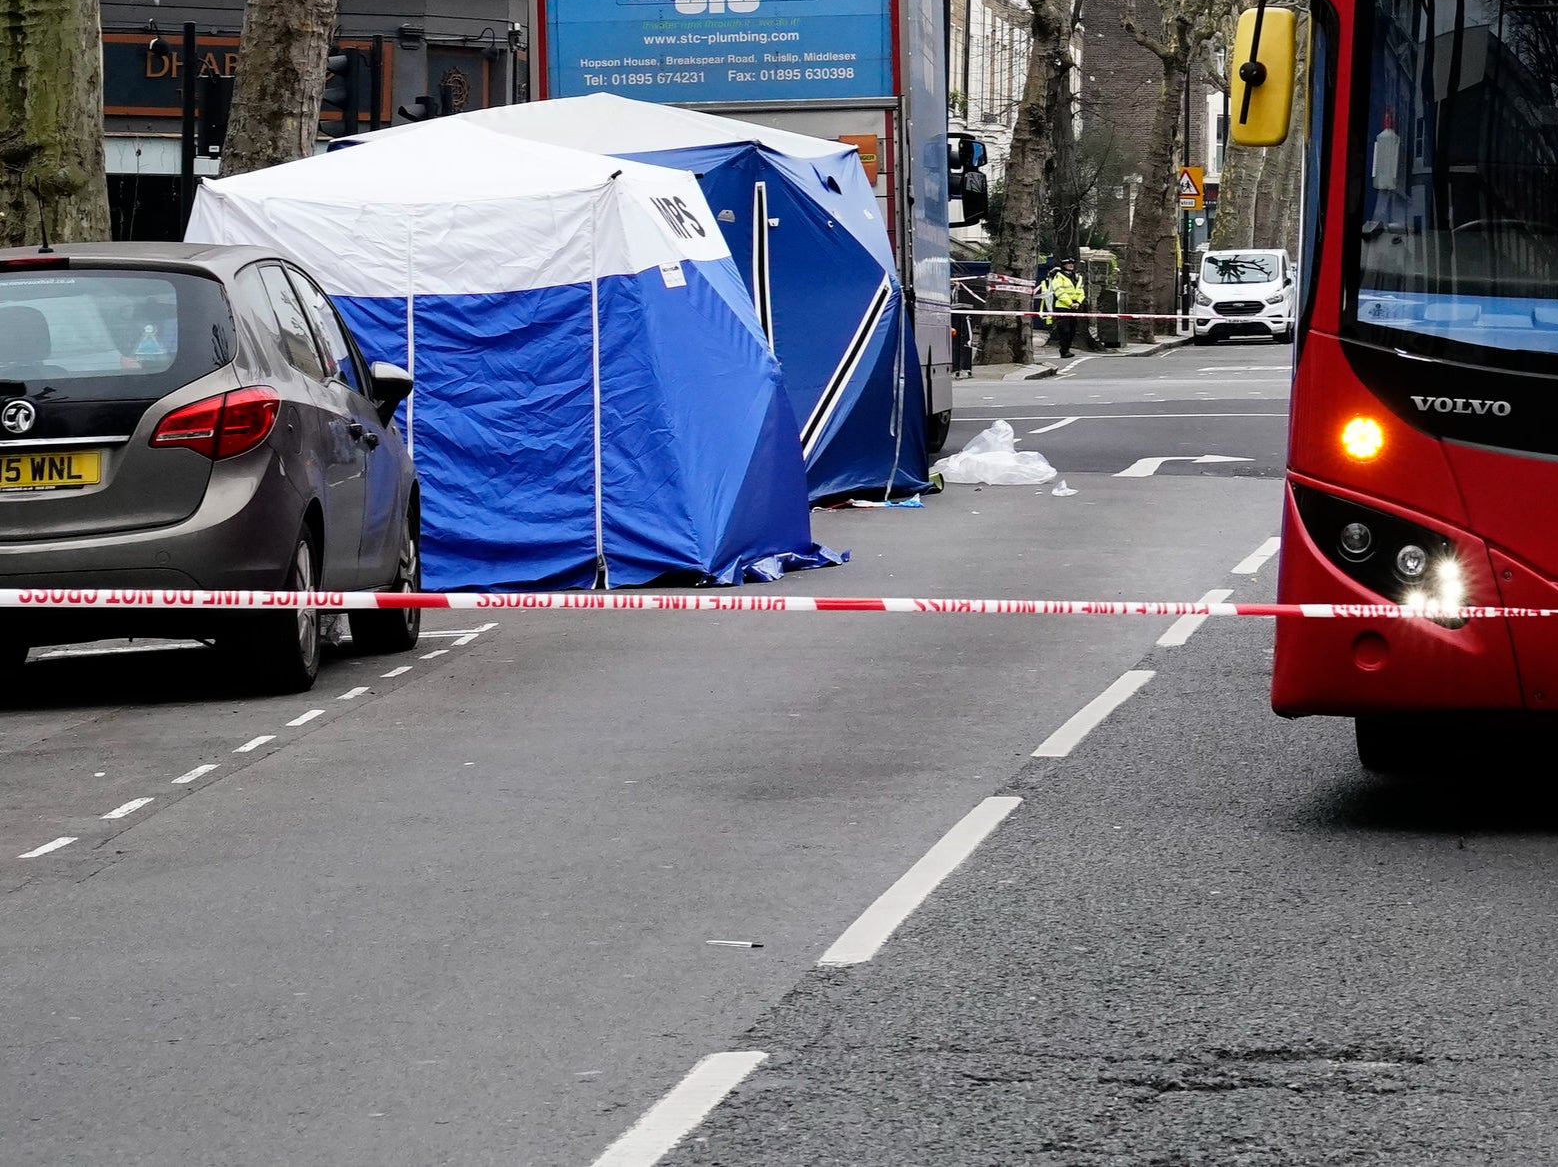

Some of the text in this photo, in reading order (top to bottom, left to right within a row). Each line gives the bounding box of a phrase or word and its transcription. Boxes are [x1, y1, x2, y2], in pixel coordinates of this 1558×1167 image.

[643, 31, 800, 45] www.stc-plumbing.com
[580, 57, 621, 69] Hopson
[666, 54, 724, 66] Breakspear
[804, 50, 856, 62] Middlesex
[584, 68, 855, 86] Tel: 01895 674231 Fax: 01895 630398
[648, 195, 706, 239] MPS
[1410, 395, 1511, 416] VOLVO
[30, 456, 82, 481] WNL
